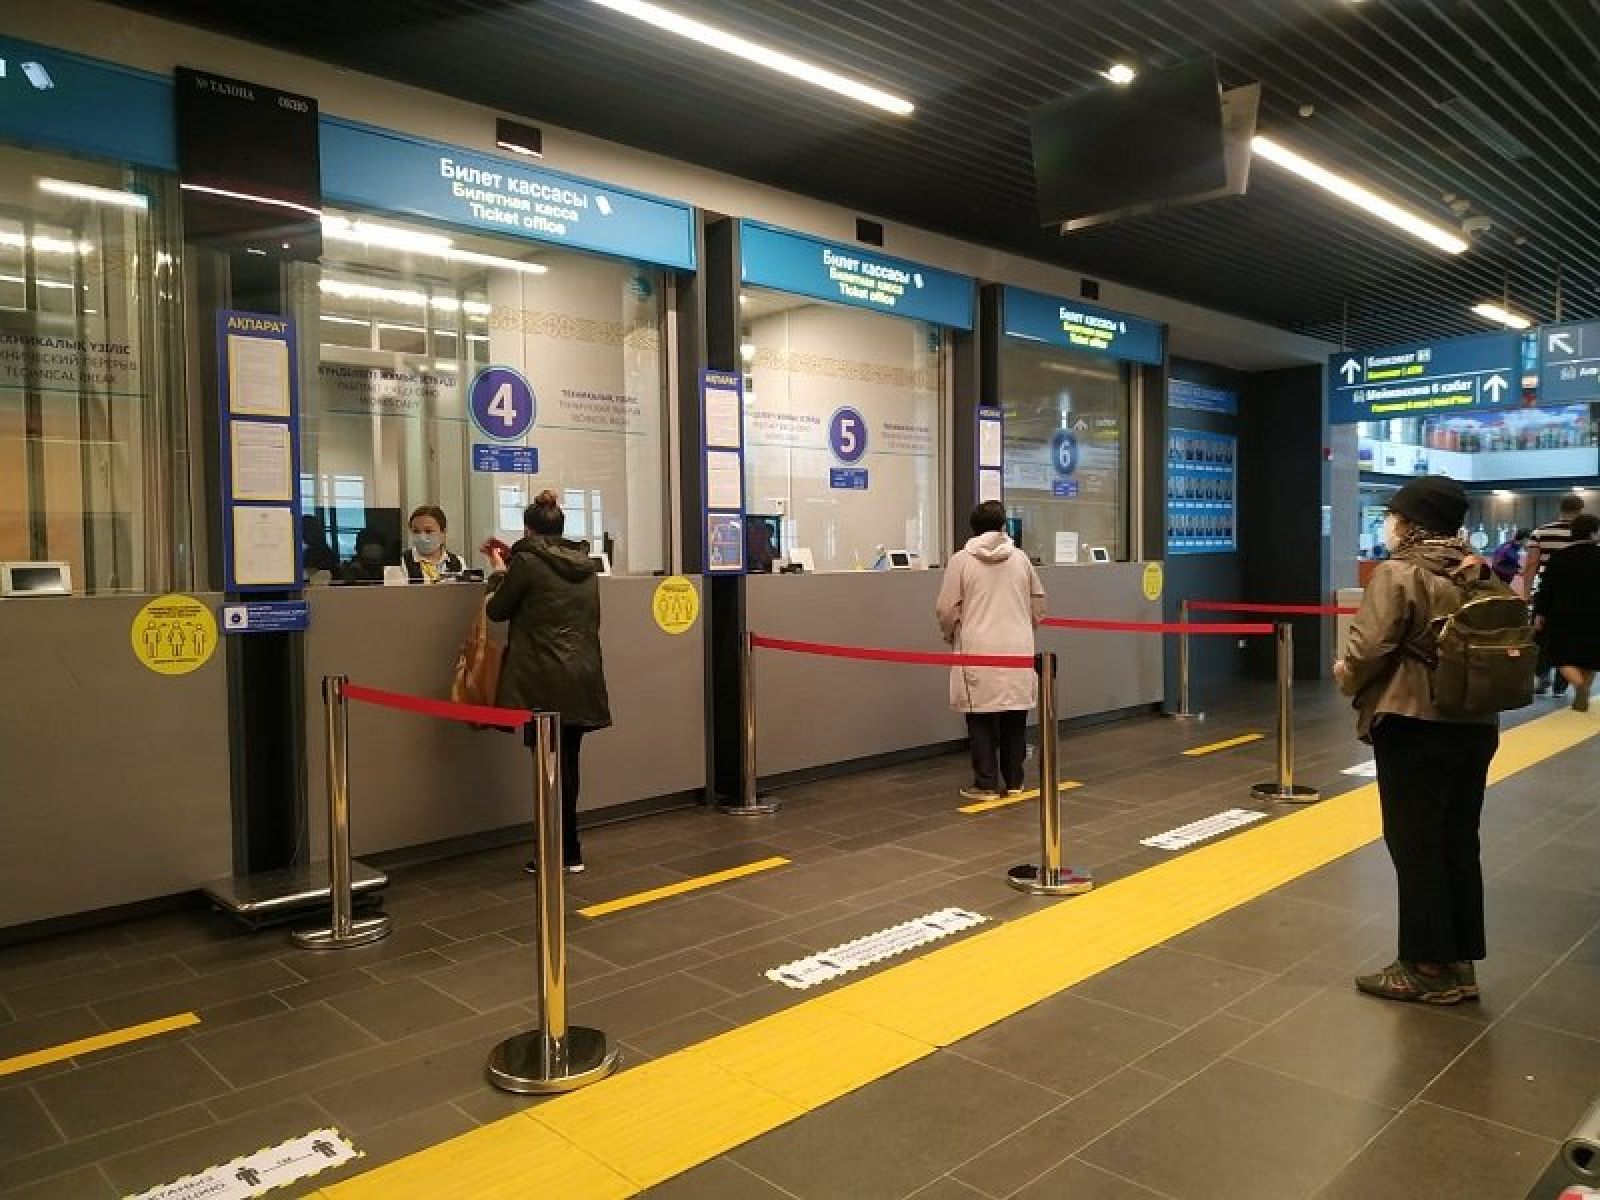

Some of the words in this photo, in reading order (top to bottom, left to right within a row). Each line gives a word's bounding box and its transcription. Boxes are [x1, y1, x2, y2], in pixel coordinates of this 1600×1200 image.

[439, 157, 502, 189] Билет
[507, 177, 589, 209] кассасы
[452, 181, 530, 212] Билетная
[535, 202, 579, 222] касса
[469, 201, 519, 227] Ticket
[523, 215, 567, 235] office
[487, 382, 517, 427] 4
[841, 418, 858, 453] 5
[1058, 439, 1072, 467] 6
